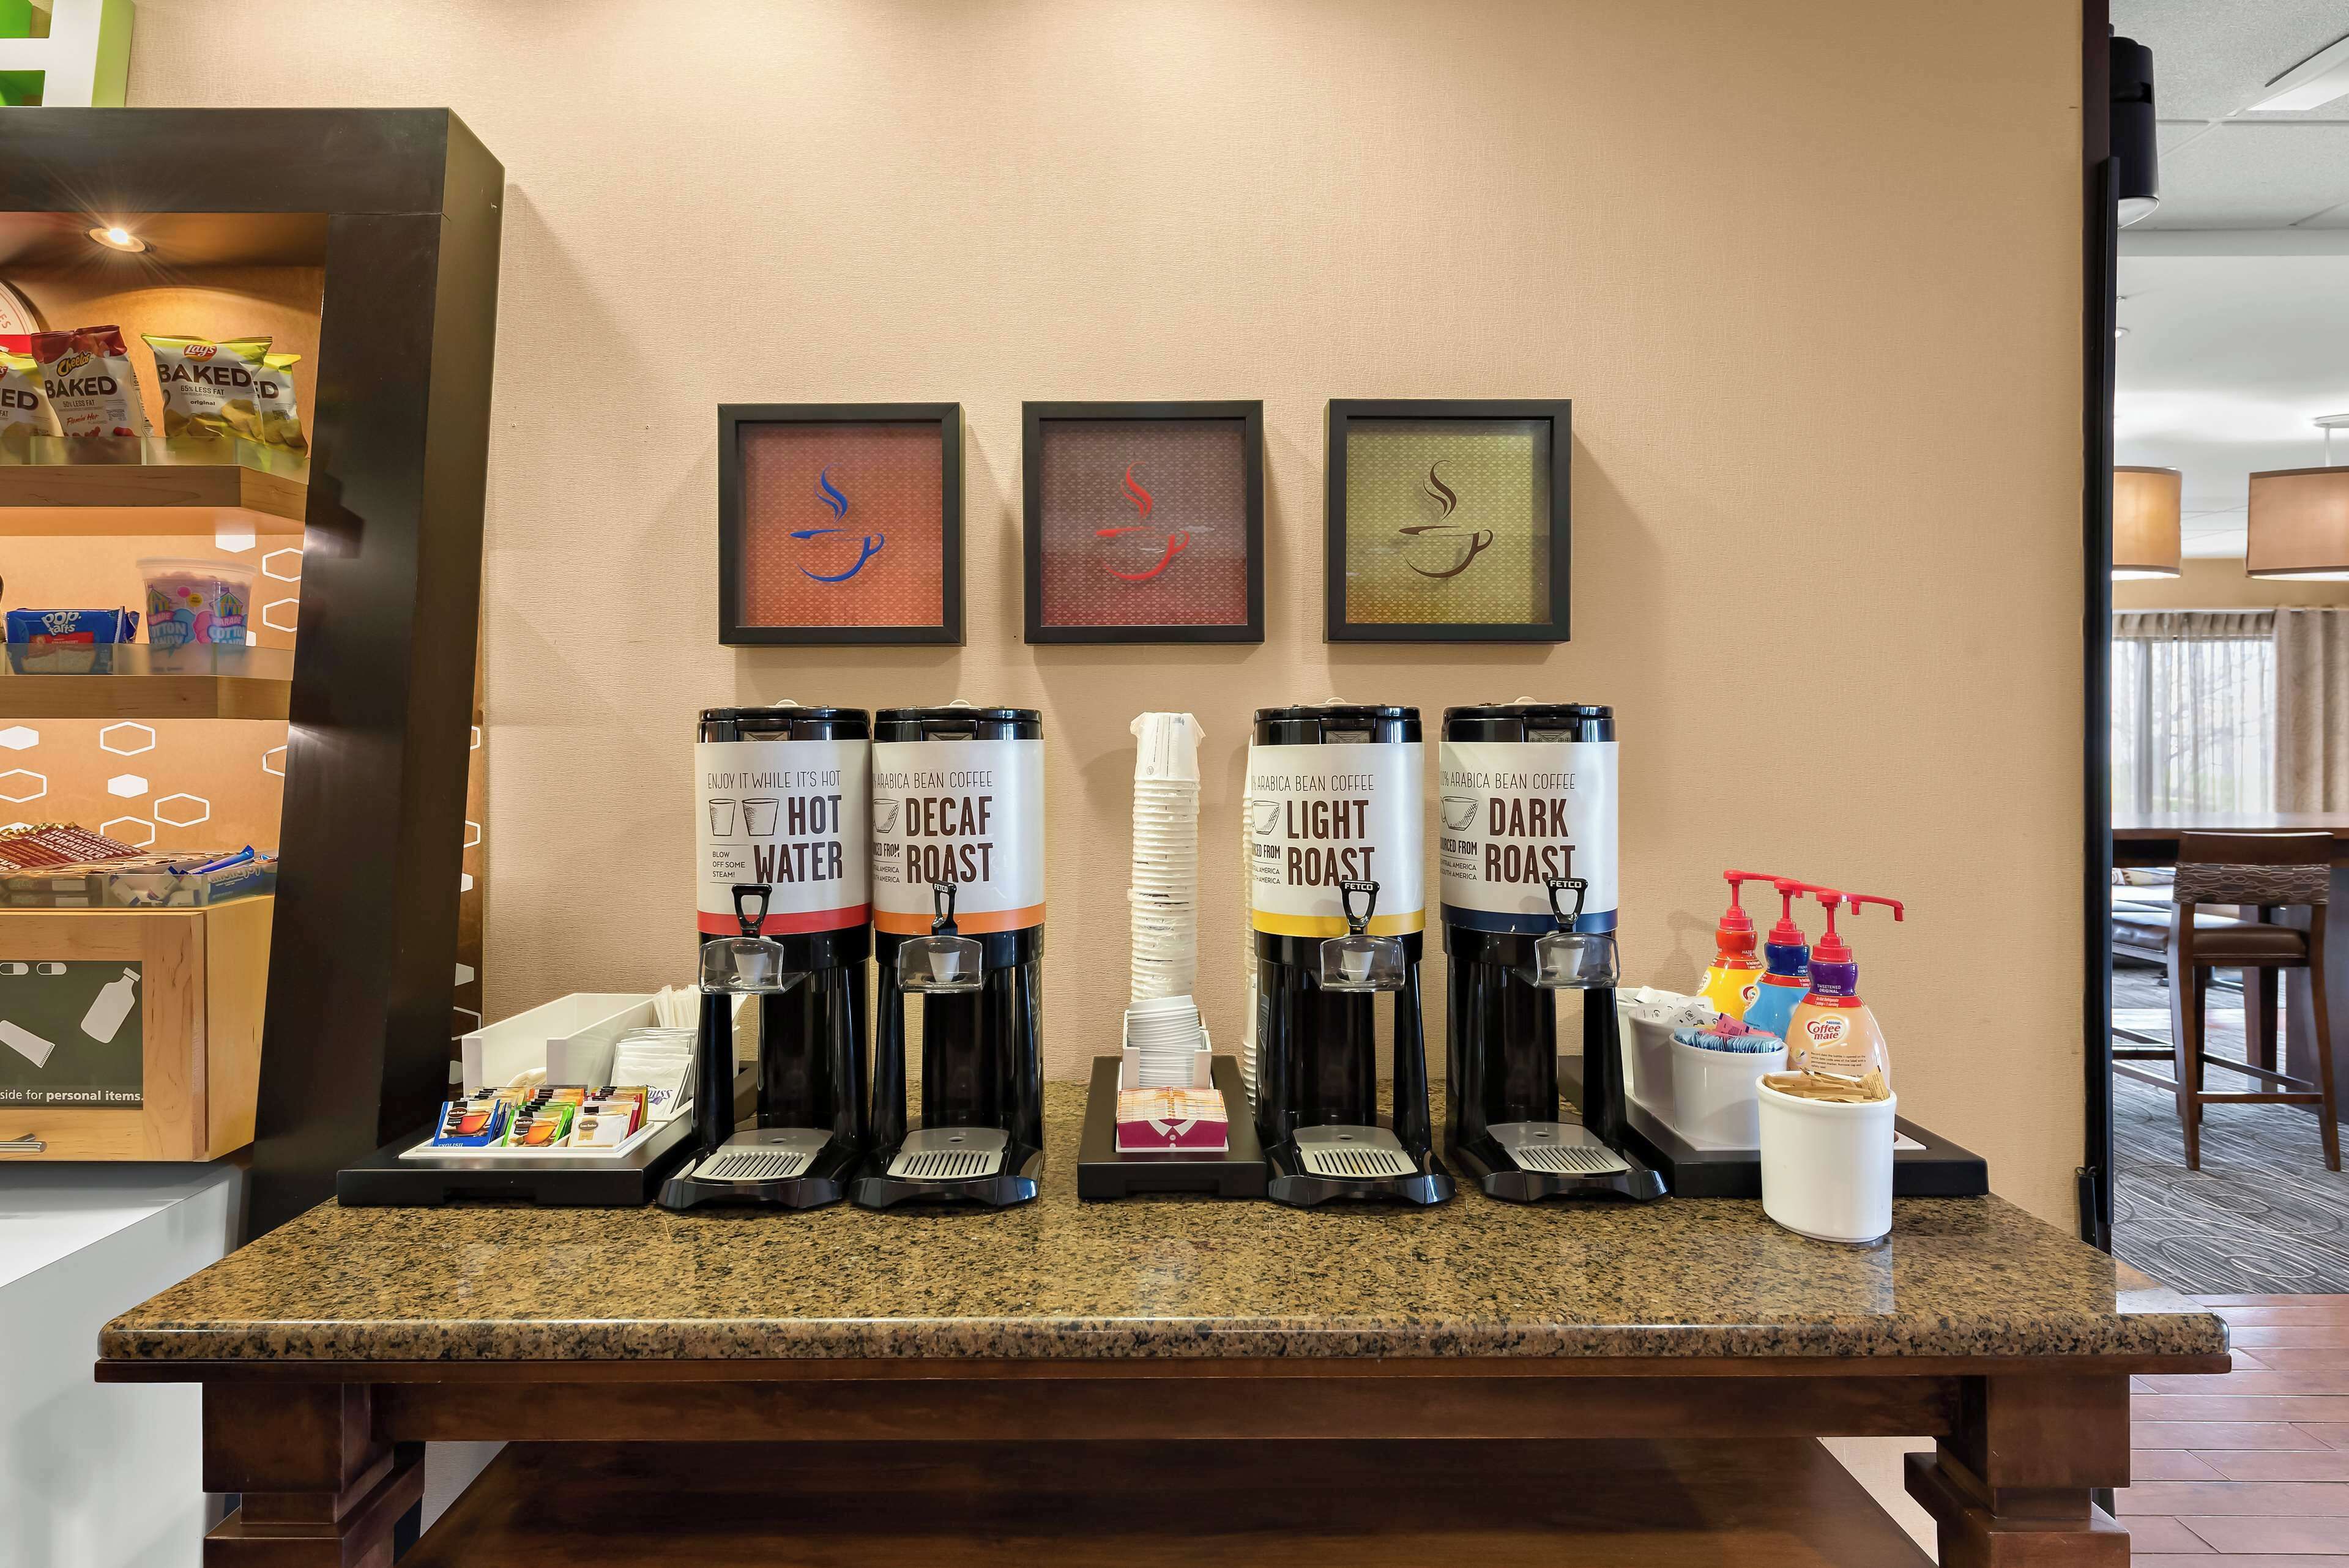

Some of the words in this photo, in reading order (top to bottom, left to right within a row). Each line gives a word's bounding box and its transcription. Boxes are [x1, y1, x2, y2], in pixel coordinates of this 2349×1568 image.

[56, 351, 91, 377] Cheetos
[157, 364, 252, 387] BAKED
[45, 376, 117, 398] BAKED
[253, 381, 279, 399] ED
[0, 388, 39, 411] ED
[708, 773, 735, 789] ENJOY
[739, 773, 748, 789] IT
[751, 771, 791, 789] WHILE
[797, 771, 817, 787] IT'S
[822, 770, 841, 786] HOT
[877, 773, 910, 789] ARABICA
[914, 772, 944, 789] BEAN
[950, 771, 993, 788] COFFEE
[1257, 775, 1291, 791] ARABICA
[1295, 775, 1325, 791] BEAN
[1331, 775, 1374, 791] COFFEE
[1450, 771, 1491, 789] ARABICA
[1495, 773, 1527, 789] BEAN
[1533, 773, 1576, 789] COFFEE
[788, 795, 842, 836] HOT
[906, 796, 992, 837] DECAF
[1287, 800, 1369, 839] LIGHT
[1489, 798, 1568, 837] DARK
[884, 843, 899, 857] FROM
[1264, 844, 1280, 859] FROM
[1458, 840, 1477, 855] FROM
[753, 841, 843, 883] WATER
[906, 842, 993, 883] ROAST
[1287, 846, 1375, 886] ROAST
[1453, 862, 1476, 871] AMERICA
[1485, 843, 1576, 884] ROAST
[1259, 876, 1281, 885] AMERICA
[1452, 872, 1477, 880] AMERICA
[1550, 880, 1582, 888] FETCO
[934, 883, 948, 892] FETCO
[1807, 1021, 1841, 1034] Coffee
[26, 1090, 43, 1100] for
[46, 1090, 101, 1102] personal
[105, 1090, 144, 1101] items.
